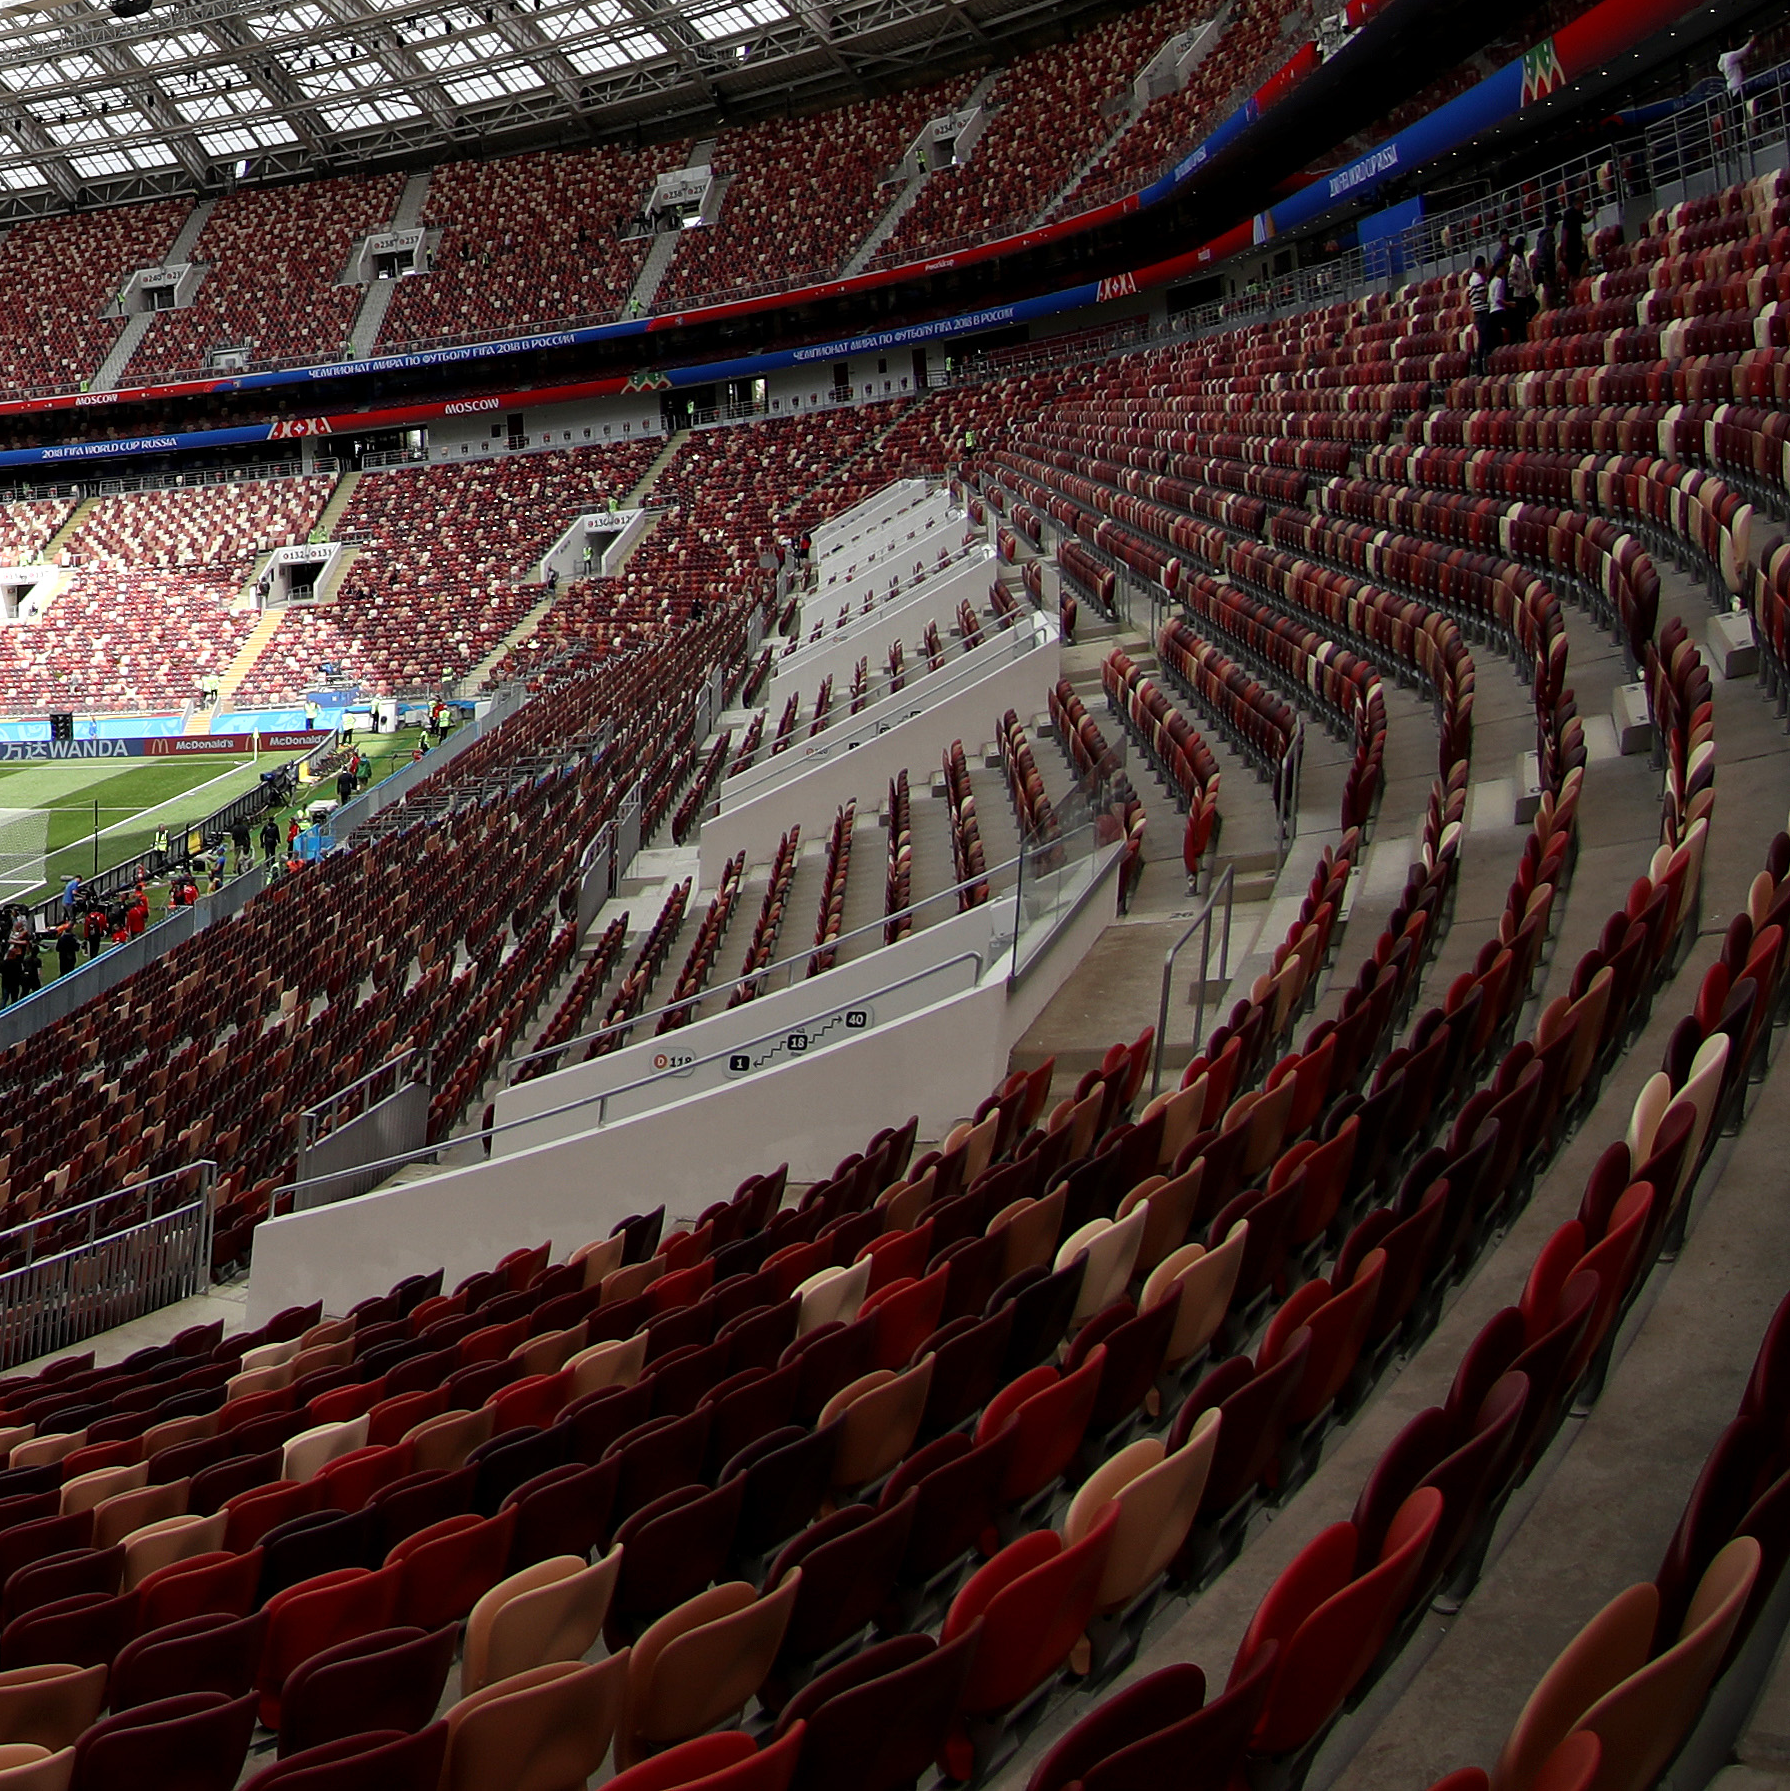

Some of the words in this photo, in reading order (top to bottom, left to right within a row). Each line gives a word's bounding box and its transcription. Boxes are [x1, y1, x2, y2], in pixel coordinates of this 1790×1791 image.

[793, 342, 849, 362] ЧЕМПИОНАТ
[850, 337, 878, 351] МИРА
[879, 334, 892, 345] ПО
[894, 325, 933, 342] ФУТБОЛУ
[934, 320, 953, 332] FIFA
[953, 316, 973, 331] 2018
[981, 306, 1014, 324] РОССИИ
[308, 362, 370, 378] ЧЕМПИОНАТ
[372, 359, 402, 370] МИРА
[405, 355, 420, 366] ПО
[422, 349, 470, 364] ФУТБОЛУ
[473, 346, 495, 357] FIFA
[496, 342, 521, 355] 2018
[522, 341, 530, 351] В
[531, 334, 576, 349] РОССИИ
[75, 393, 118, 406] MOSCOW
[444, 397, 500, 415] MOSCOW
[41, 448, 63, 460] 2018
[64, 446, 84, 458] FIFA
[85, 442, 118, 456] WORLD
[120, 440, 140, 452] CUP
[141, 437, 177, 450] RUSSIA
[2, 741, 48, 760] 万达
[48, 739, 129, 758] WANDA
[175, 738, 234, 750] McDonald's
[849, 1015, 864, 1025] 40
[791, 1038, 805, 1048] 18
